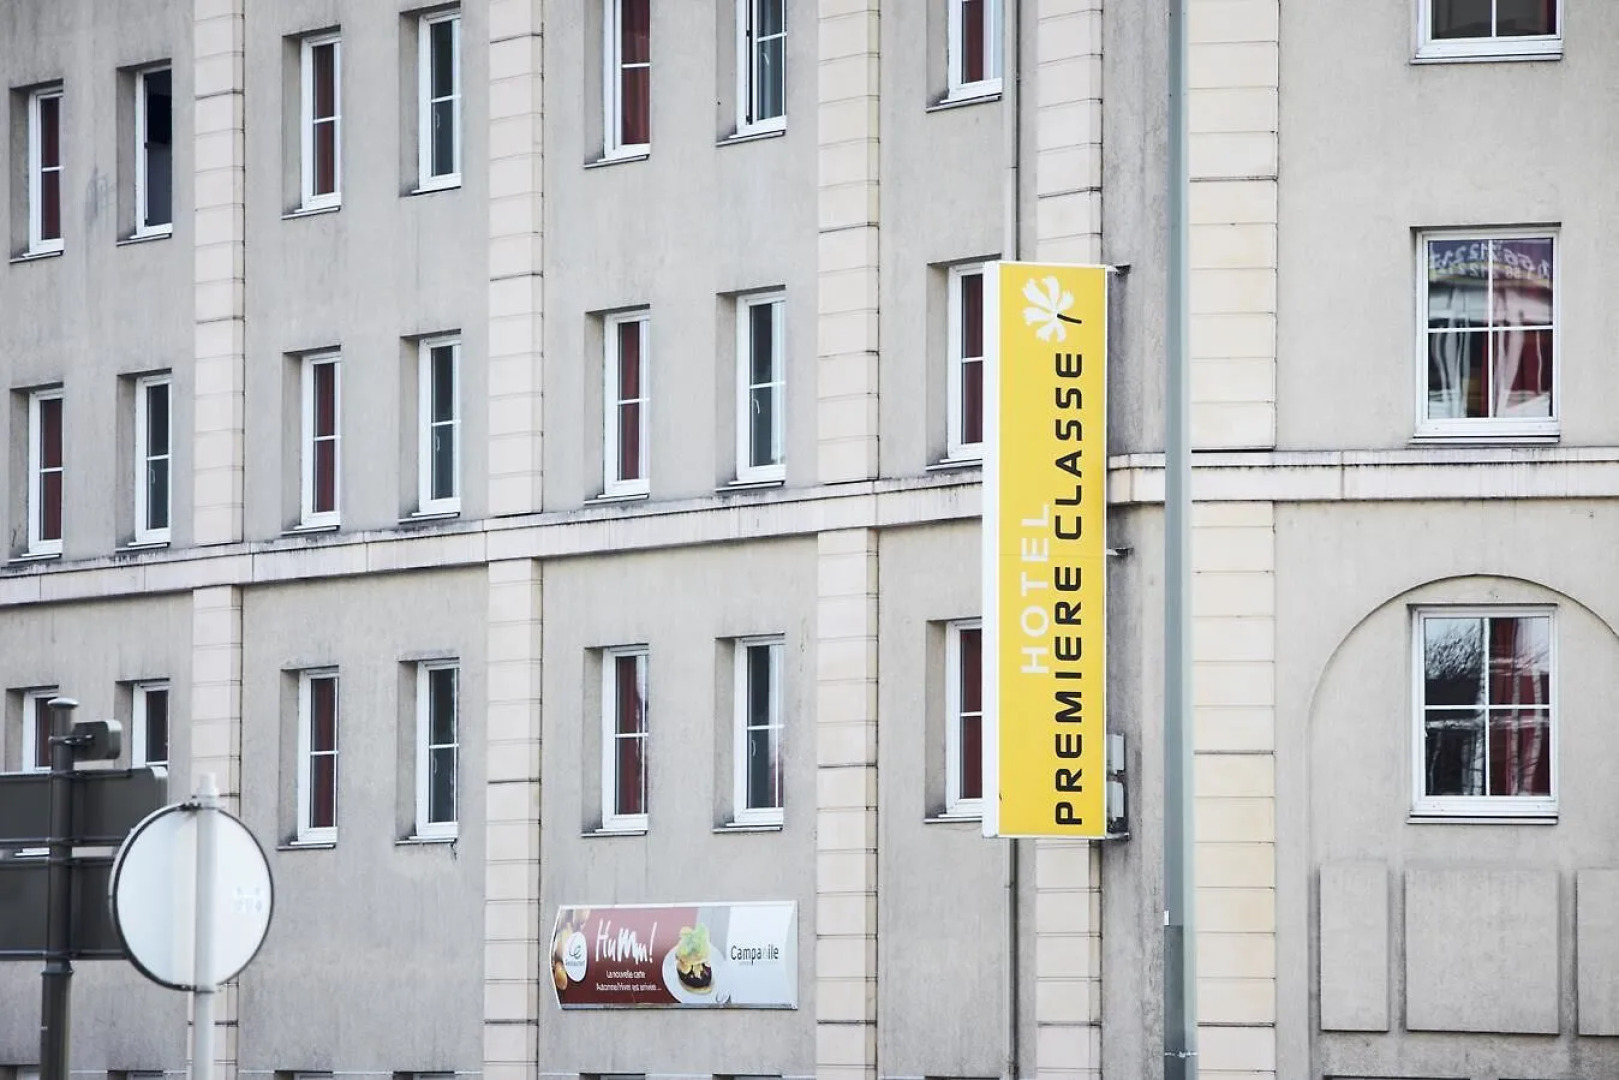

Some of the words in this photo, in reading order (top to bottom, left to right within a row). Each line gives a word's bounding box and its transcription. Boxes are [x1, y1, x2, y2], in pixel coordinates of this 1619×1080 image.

[1054, 352, 1083, 540] CLASSE
[1021, 504, 1049, 674] HOTEL
[1054, 566, 1083, 826] PREMIERE
[730, 944, 779, 966] Campaile
